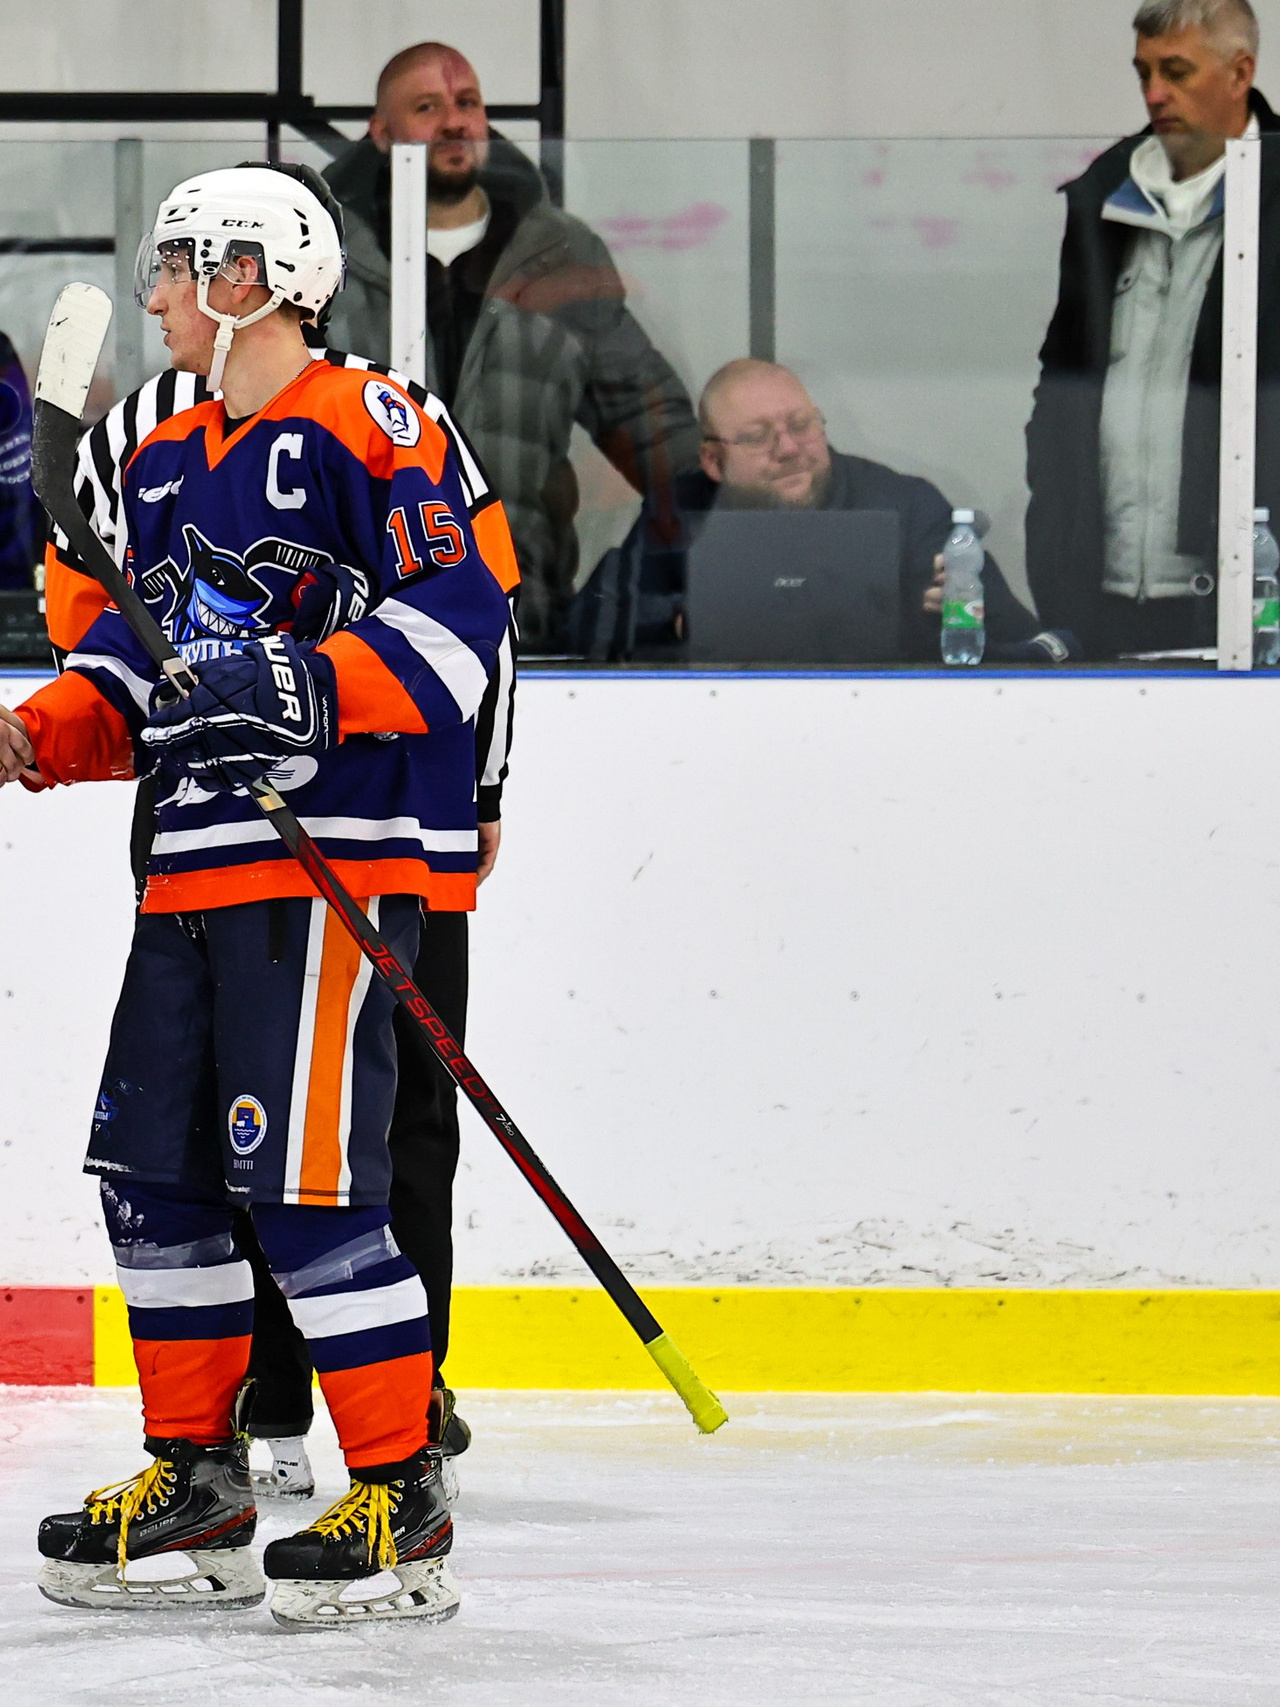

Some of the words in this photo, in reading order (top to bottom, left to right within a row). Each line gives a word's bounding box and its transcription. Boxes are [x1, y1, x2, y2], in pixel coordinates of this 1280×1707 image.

[221, 219, 265, 229] CCM
[265, 432, 307, 510] C
[386, 500, 467, 580] 15
[363, 939, 487, 1098] JETSPEED
